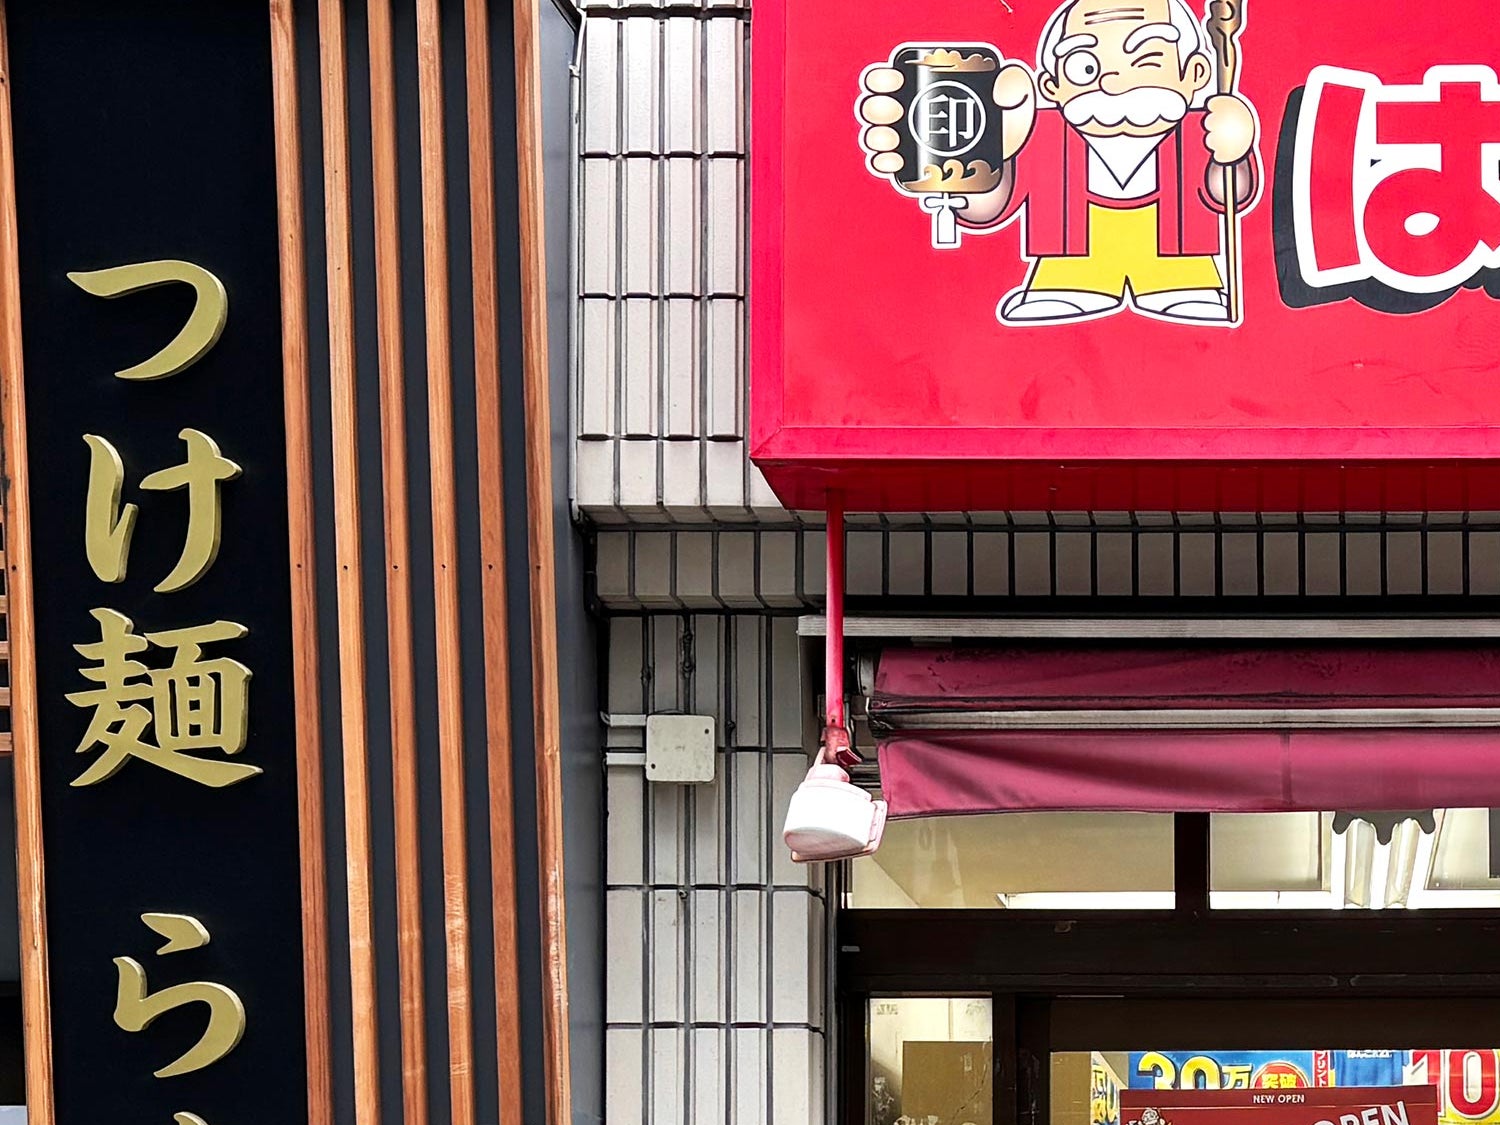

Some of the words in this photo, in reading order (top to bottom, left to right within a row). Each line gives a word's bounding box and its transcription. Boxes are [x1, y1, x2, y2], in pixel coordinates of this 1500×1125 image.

[65, 258, 264, 788] つけ麺
[1253, 1095, 1275, 1103] NEW
[1277, 1094, 1305, 1103] OPEN
